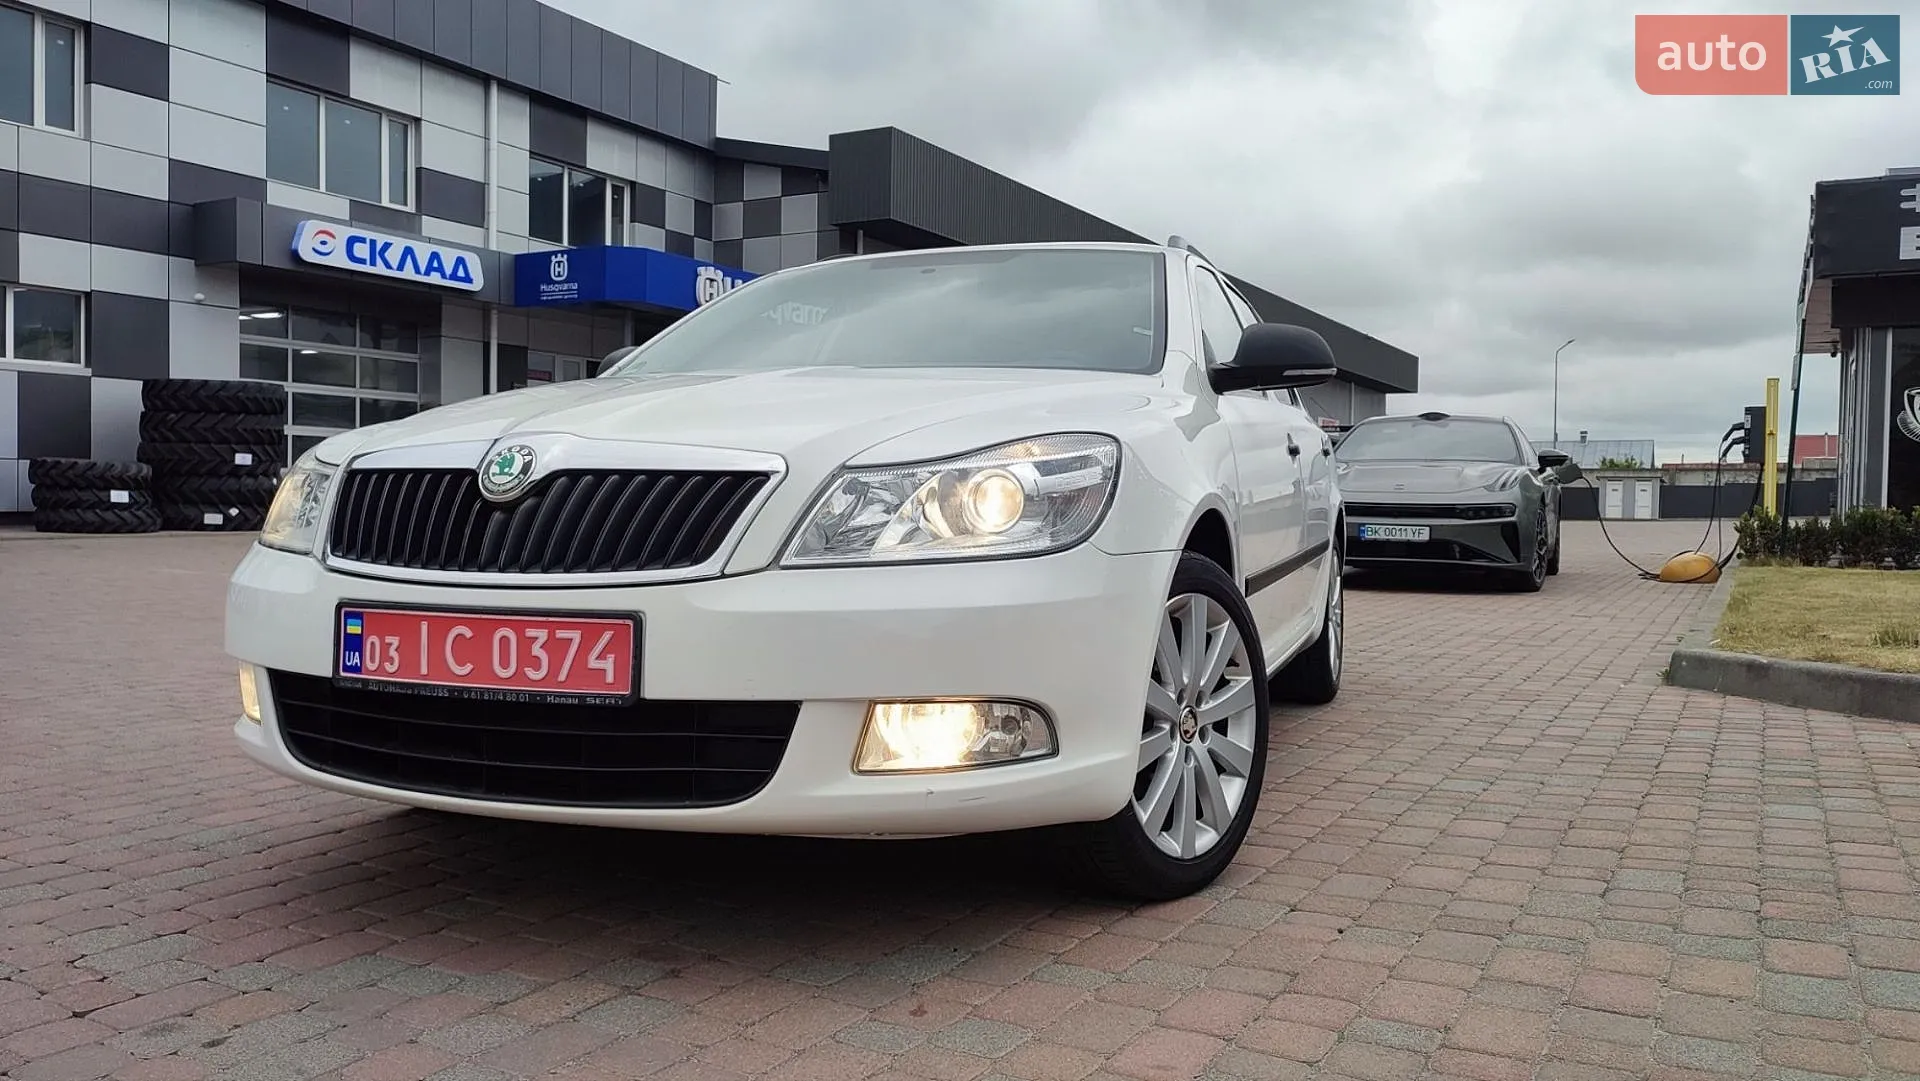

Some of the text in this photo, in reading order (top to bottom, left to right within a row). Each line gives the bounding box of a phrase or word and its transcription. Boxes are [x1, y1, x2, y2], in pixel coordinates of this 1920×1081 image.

[345, 235, 474, 284] СКЛАД
[540, 282, 578, 292] Husqvarna
[1366, 526, 1425, 538] BK 0011 YF
[345, 651, 361, 666] UA
[366, 635, 400, 674] 03
[492, 627, 615, 684] 0374
[547, 695, 579, 705] Hanau
